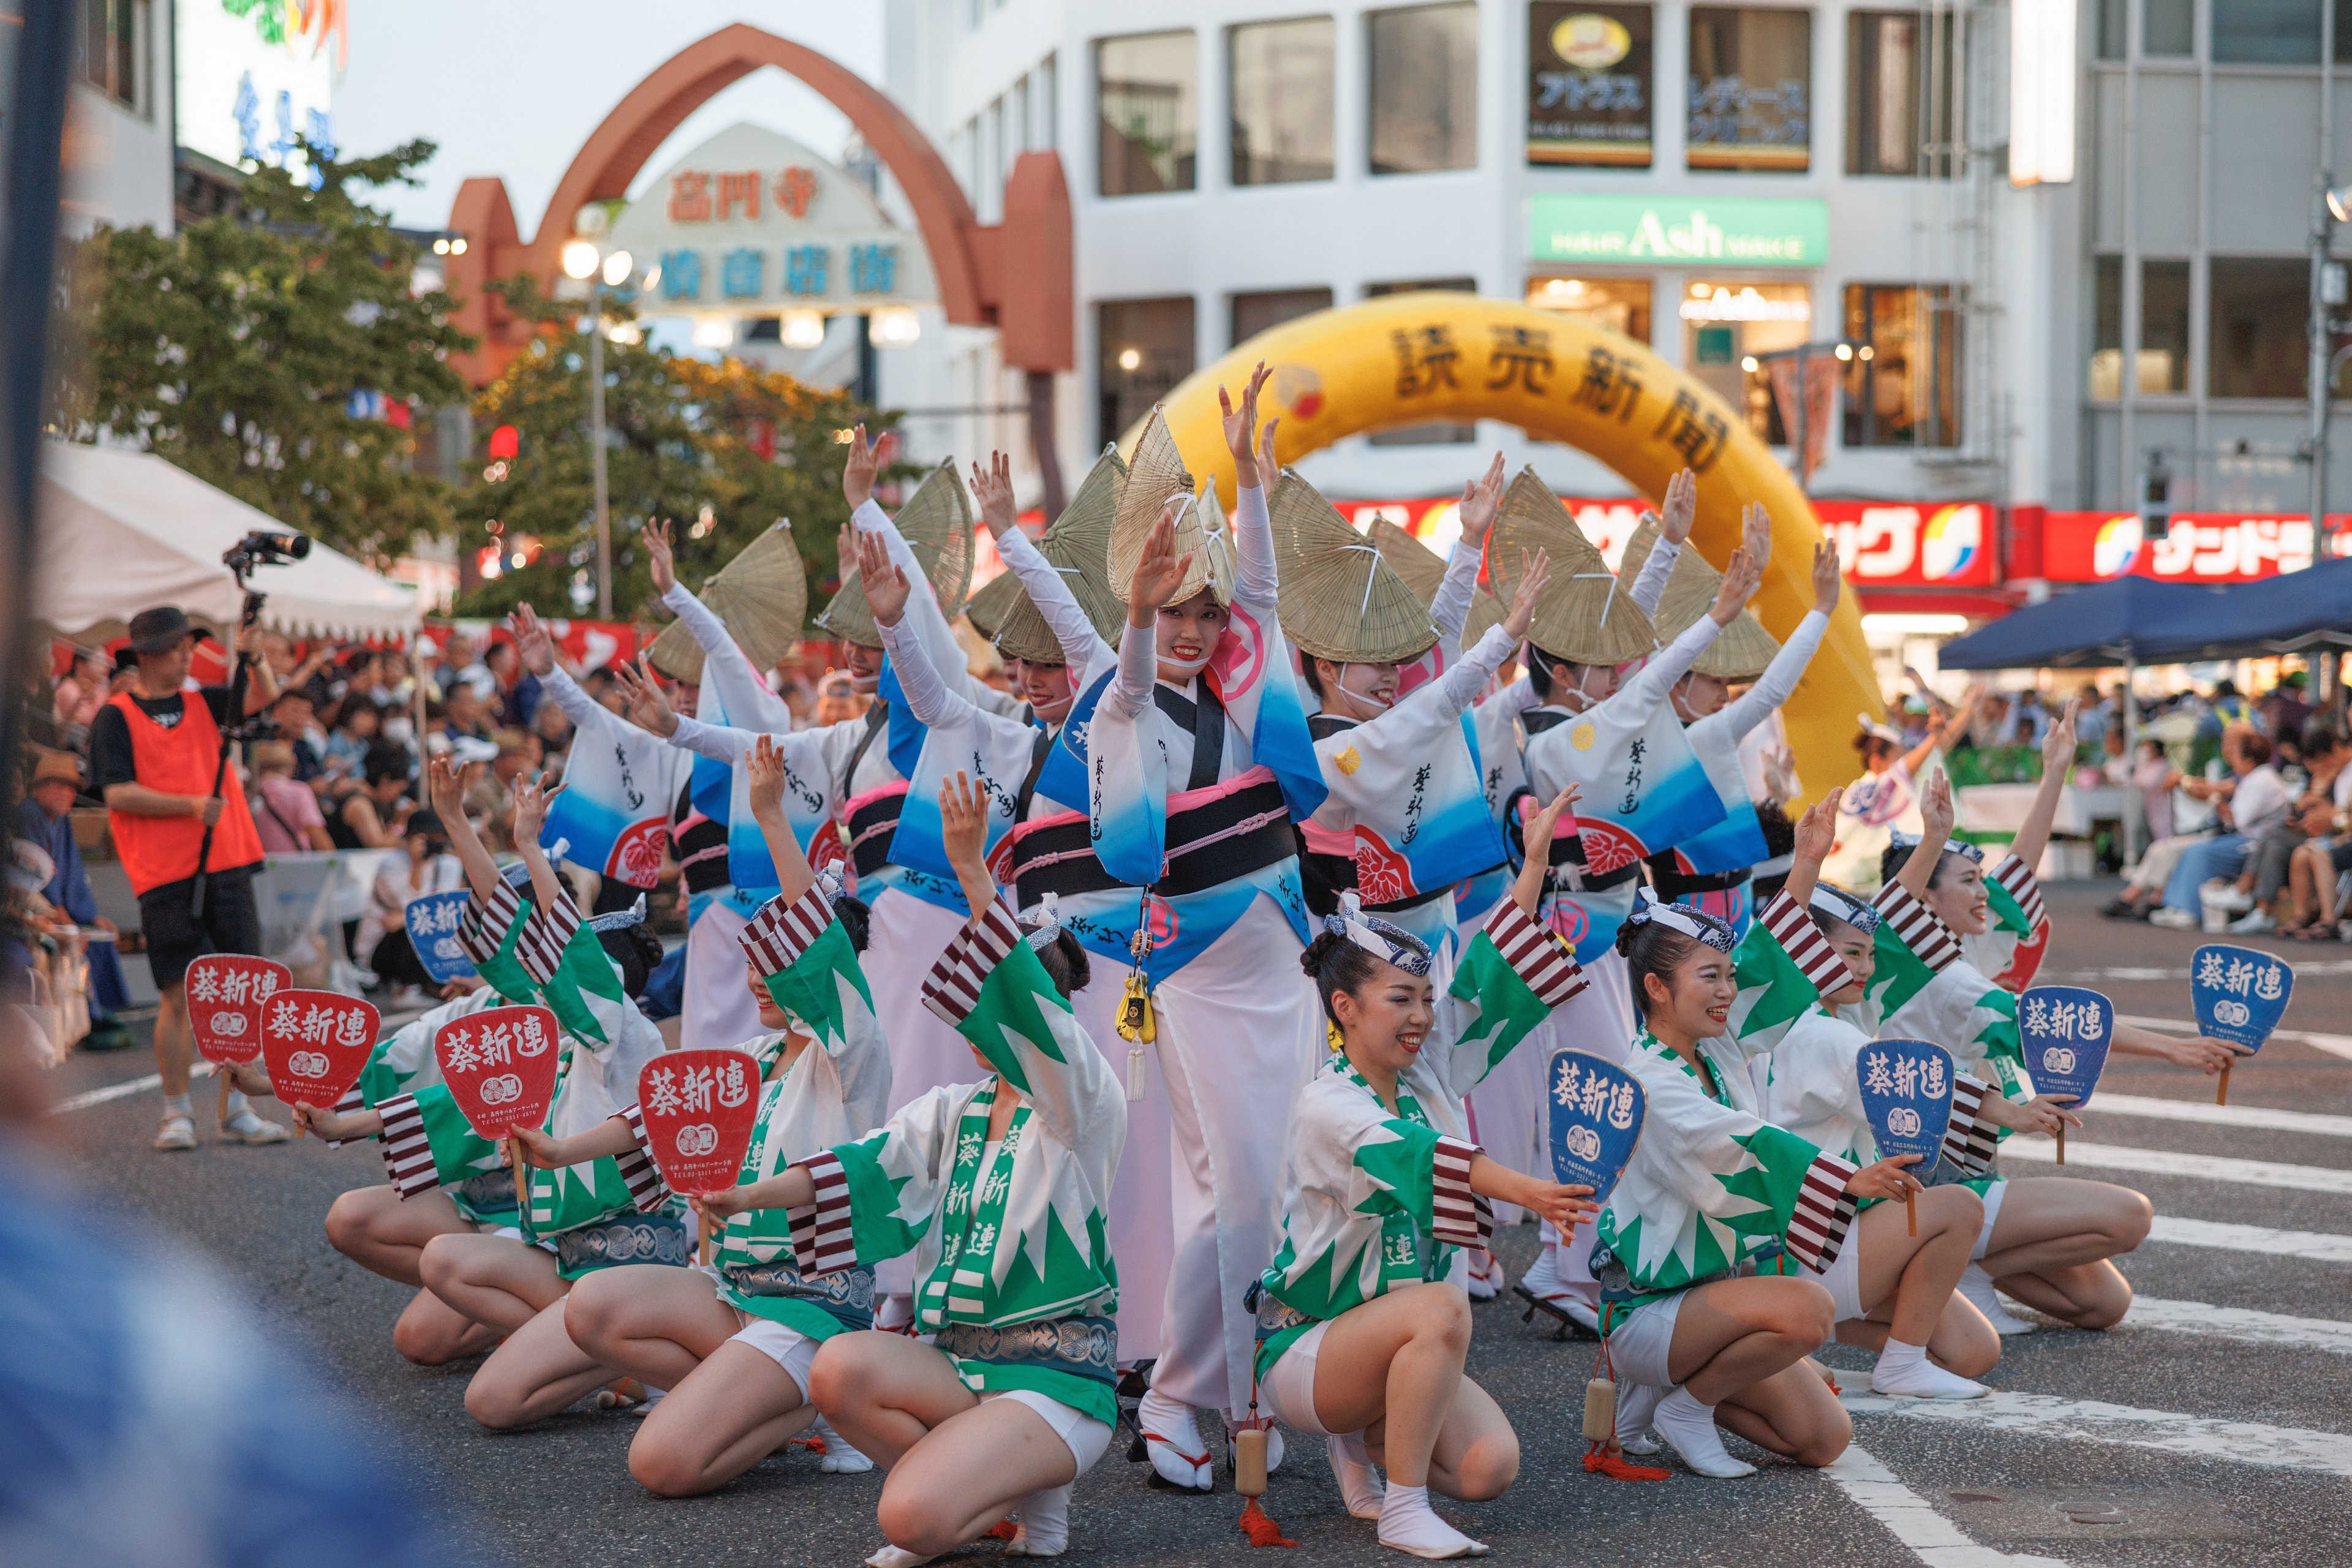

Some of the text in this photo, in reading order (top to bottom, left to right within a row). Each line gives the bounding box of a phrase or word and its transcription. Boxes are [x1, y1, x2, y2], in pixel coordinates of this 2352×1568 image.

[1536, 70, 1645, 111] アトラス
[668, 165, 818, 223] 高円寺
[1627, 209, 1723, 258] Ash
[594, 240, 898, 304] 情商店街
[1390, 324, 1728, 473] 読売新聞
[190, 965, 278, 1006] 葵新連
[2196, 952, 2282, 1000] 葵新連
[266, 1000, 367, 1046] 葵新連
[445, 1014, 549, 1073] 葵新連
[2023, 997, 2103, 1041] 葵新連
[646, 1059, 748, 1117] 葵新連
[1552, 1058, 1634, 1129] 葵新連
[1864, 1051, 1947, 1100] 葵新連
[490, 1102, 539, 1118] 高円寺パルアーケード内
[683, 1159, 732, 1170] 高円寺パルアーケード内
[940, 1132, 982, 1267] 葵新連
[965, 1123, 1025, 1256] 葵新連
